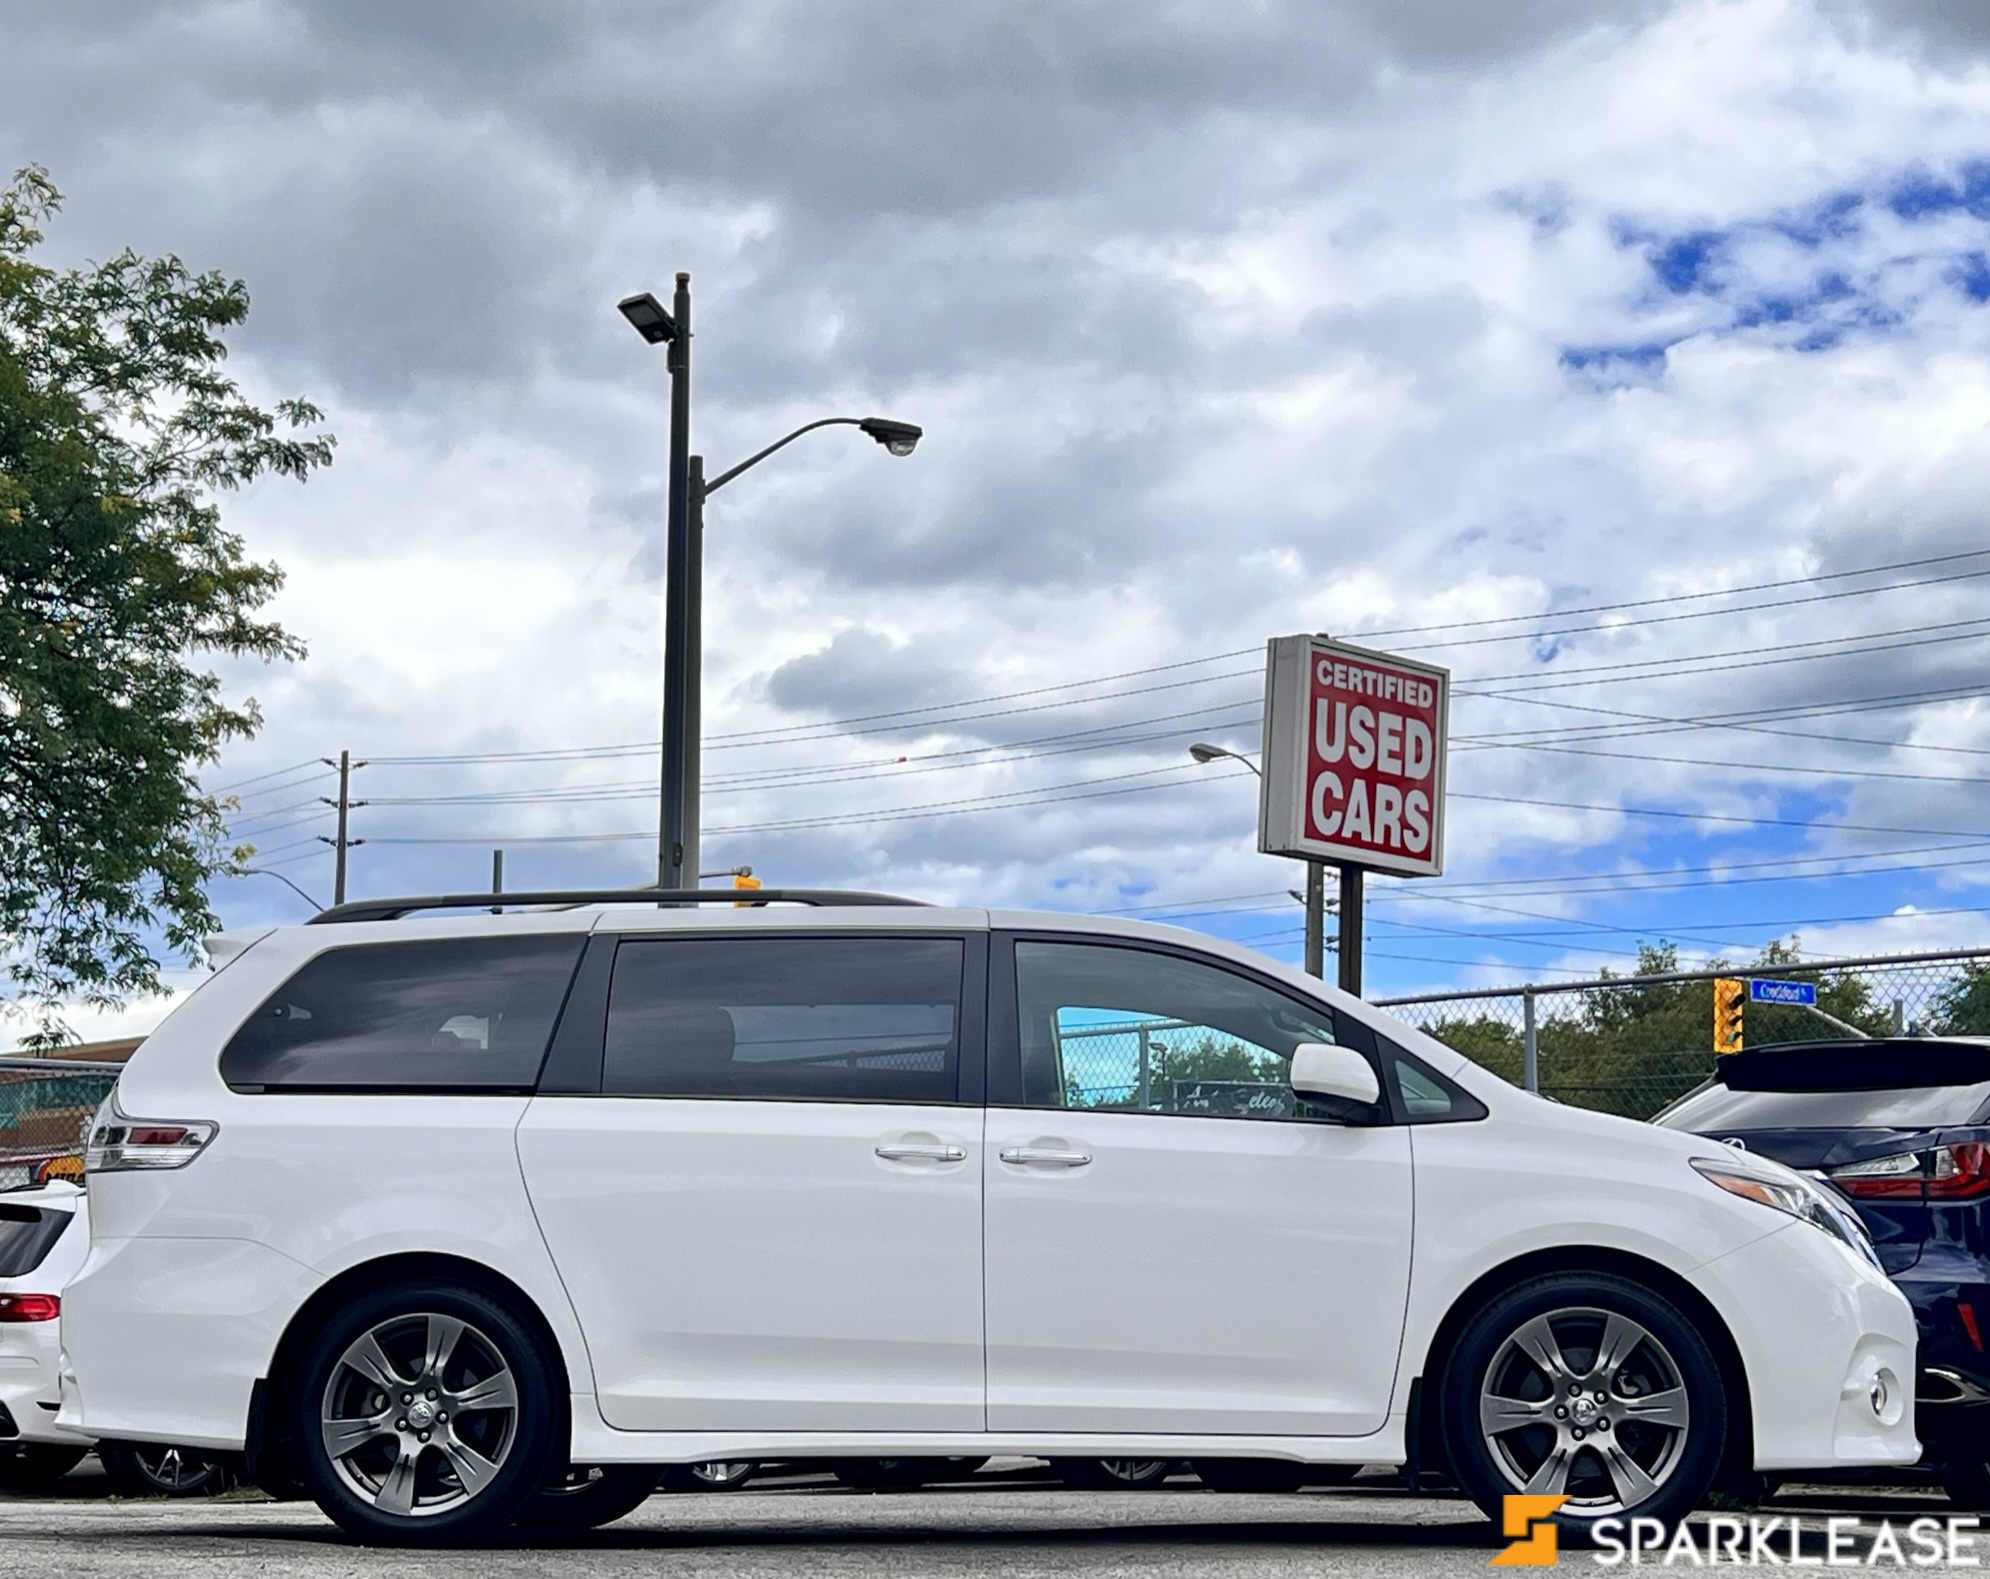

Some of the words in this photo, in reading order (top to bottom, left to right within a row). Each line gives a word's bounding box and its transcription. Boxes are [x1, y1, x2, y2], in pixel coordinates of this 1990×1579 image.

[1316, 659, 1433, 709] CERTIFIED
[1315, 697, 1433, 780] USED
[1311, 770, 1430, 853] CARS
